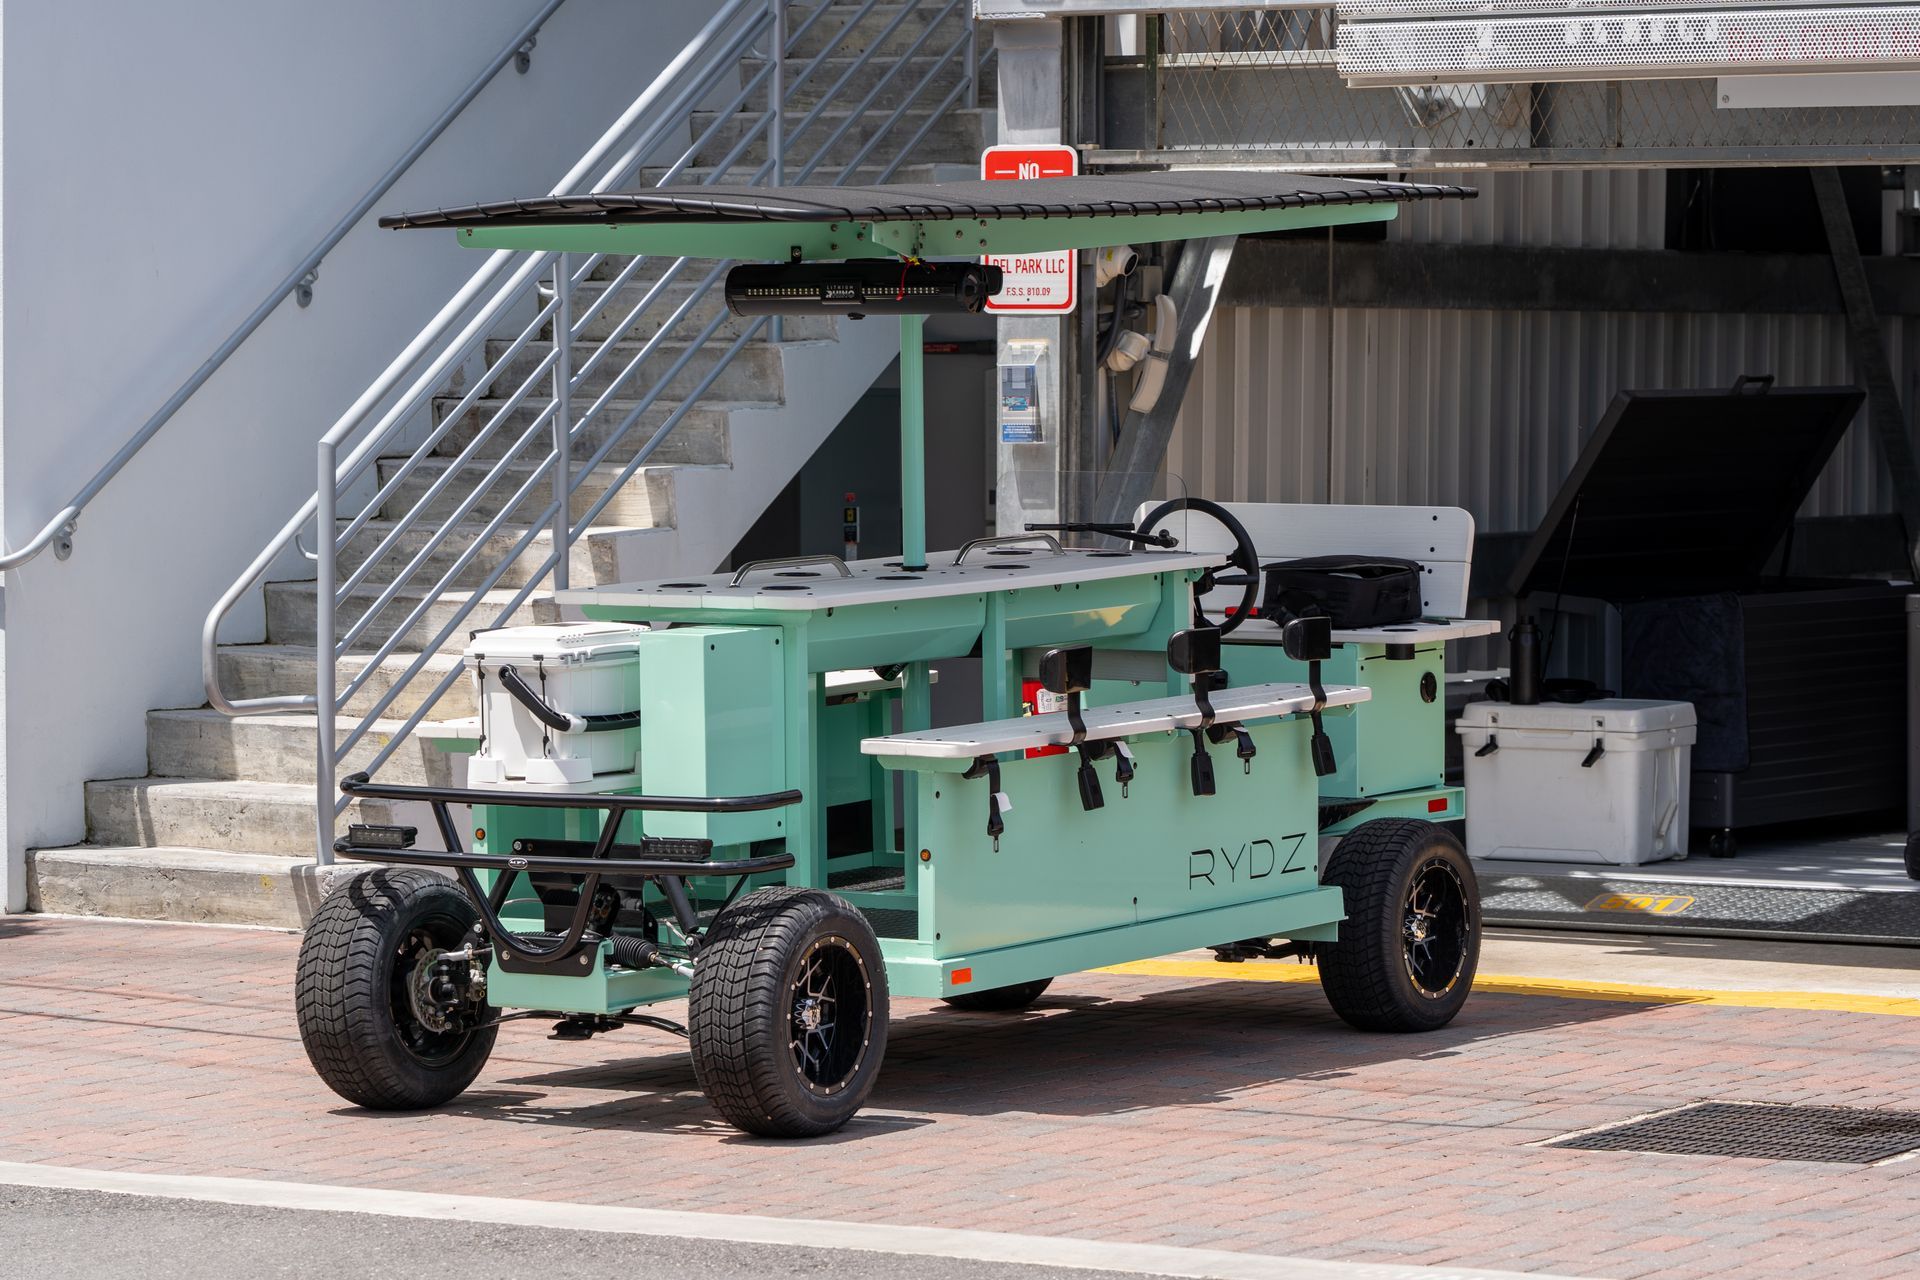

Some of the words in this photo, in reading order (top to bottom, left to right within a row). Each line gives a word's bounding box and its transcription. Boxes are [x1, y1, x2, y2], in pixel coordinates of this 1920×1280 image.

[1018, 162, 1040, 180] NO
[1015, 258, 1043, 274] PARK
[1045, 258, 1065, 274] LLC
[1006, 287, 1026, 296] F.S.S.
[1027, 287, 1051, 296] 810.09
[1188, 831, 1308, 891] RYDZ
[1599, 896, 1674, 912] 501
